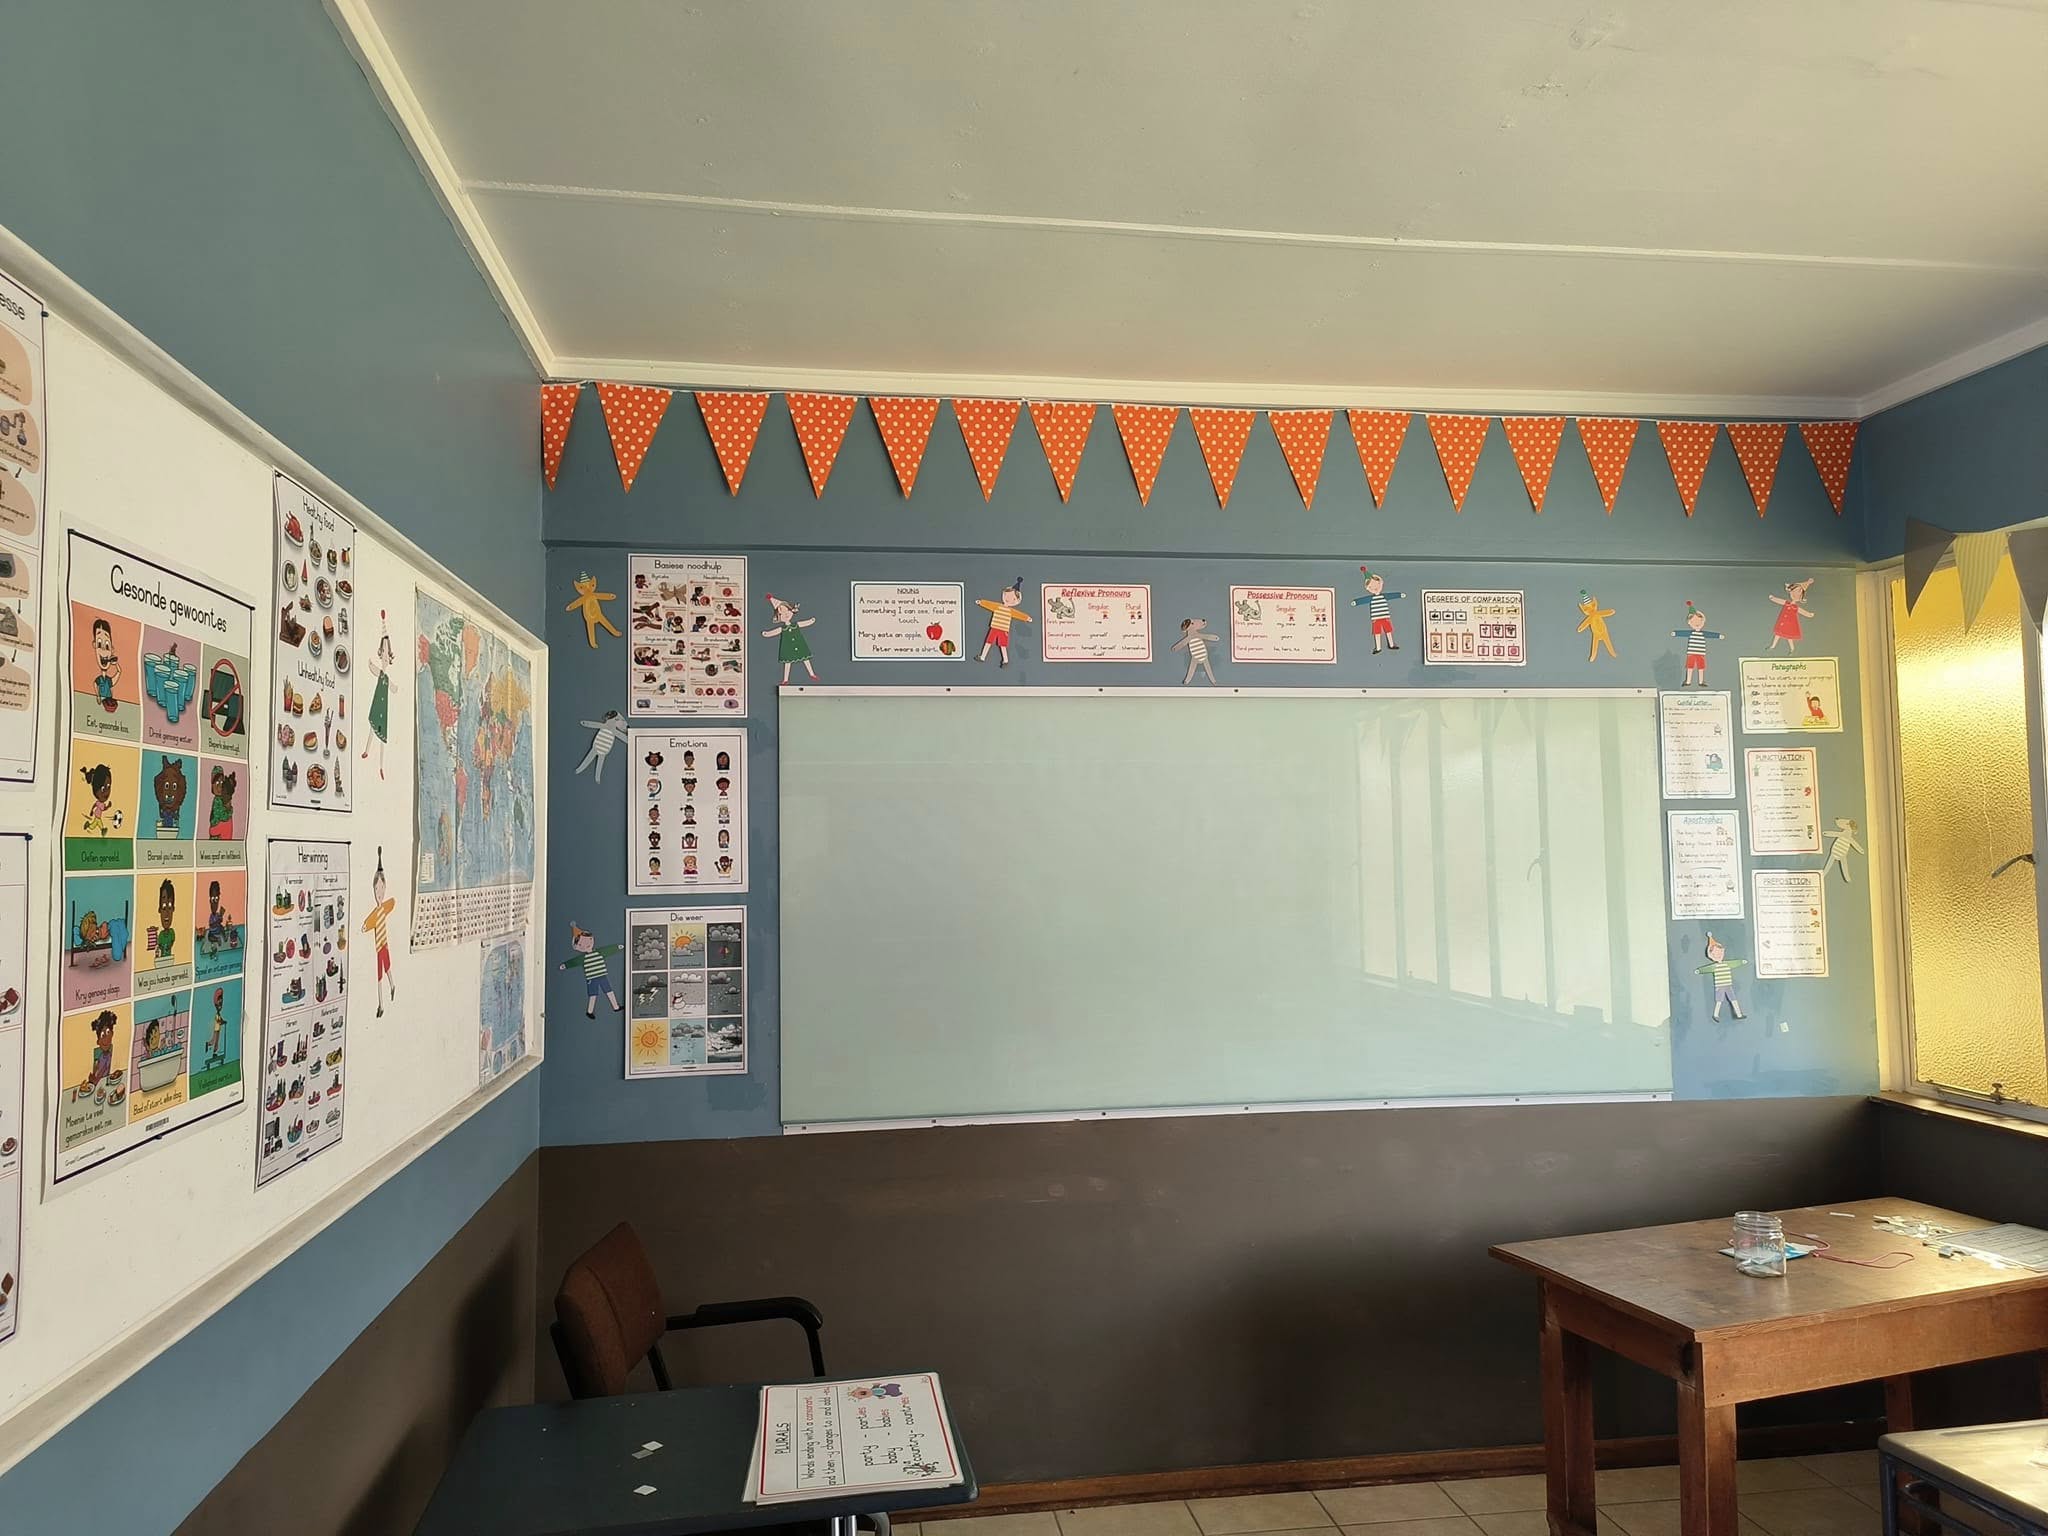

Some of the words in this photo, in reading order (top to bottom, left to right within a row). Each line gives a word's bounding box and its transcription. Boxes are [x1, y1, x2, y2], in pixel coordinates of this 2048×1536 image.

[303, 496, 323, 530] Healthy
[324, 512, 335, 531] food
[655, 560, 684, 569] Basiese
[687, 561, 722, 573] noodhulp
[110, 564, 167, 610] Gesonde
[169, 599, 227, 633] gewoontes
[1061, 588, 1096, 597] Reflexive
[1098, 589, 1132, 598] Pronouns
[1247, 591, 1283, 600] Possessive
[1285, 592, 1318, 600] Pronouns
[1473, 596, 1521, 604] COMPARISON
[862, 606, 896, 616] something
[898, 606, 902, 614] I
[1087, 603, 1110, 611] Singular
[1310, 605, 1326, 613] Plural
[858, 631, 876, 640] Mary
[298, 660, 324, 691] Unhealthy
[325, 671, 335, 689] food
[1772, 663, 1807, 672] Paragraphs
[669, 738, 708, 748] Emotions
[298, 846, 328, 870] Herwinning
[670, 912, 684, 922] Die
[138, 977, 148, 987] Was
[147, 979, 156, 990] jou
[157, 972, 170, 984] hande
[75, 989, 87, 1004] Kry
[88, 989, 107, 1003] genoeg
[107, 984, 120, 998] slaap
[133, 1104, 143, 1115] Bad
[143, 1099, 151, 1111] of
[149, 1098, 163, 1110] stort
[818, 1397, 831, 1406] add
[818, 1407, 832, 1416] and
[856, 1407, 870, 1429] parties
[876, 1408, 892, 1427] babies
[900, 1396, 914, 1425] countries
[823, 1420, 832, 1428] to
[774, 1422, 790, 1455] PLURALS
[800, 1427, 814, 1440] with
[820, 1429, 839, 1450] changes
[800, 1441, 820, 1459] ending
[859, 1445, 879, 1466] party
[880, 1447, 904, 1464] baby
[906, 1433, 925, 1461] country
[800, 1461, 815, 1480] Words
[822, 1476, 837, 1486] and
